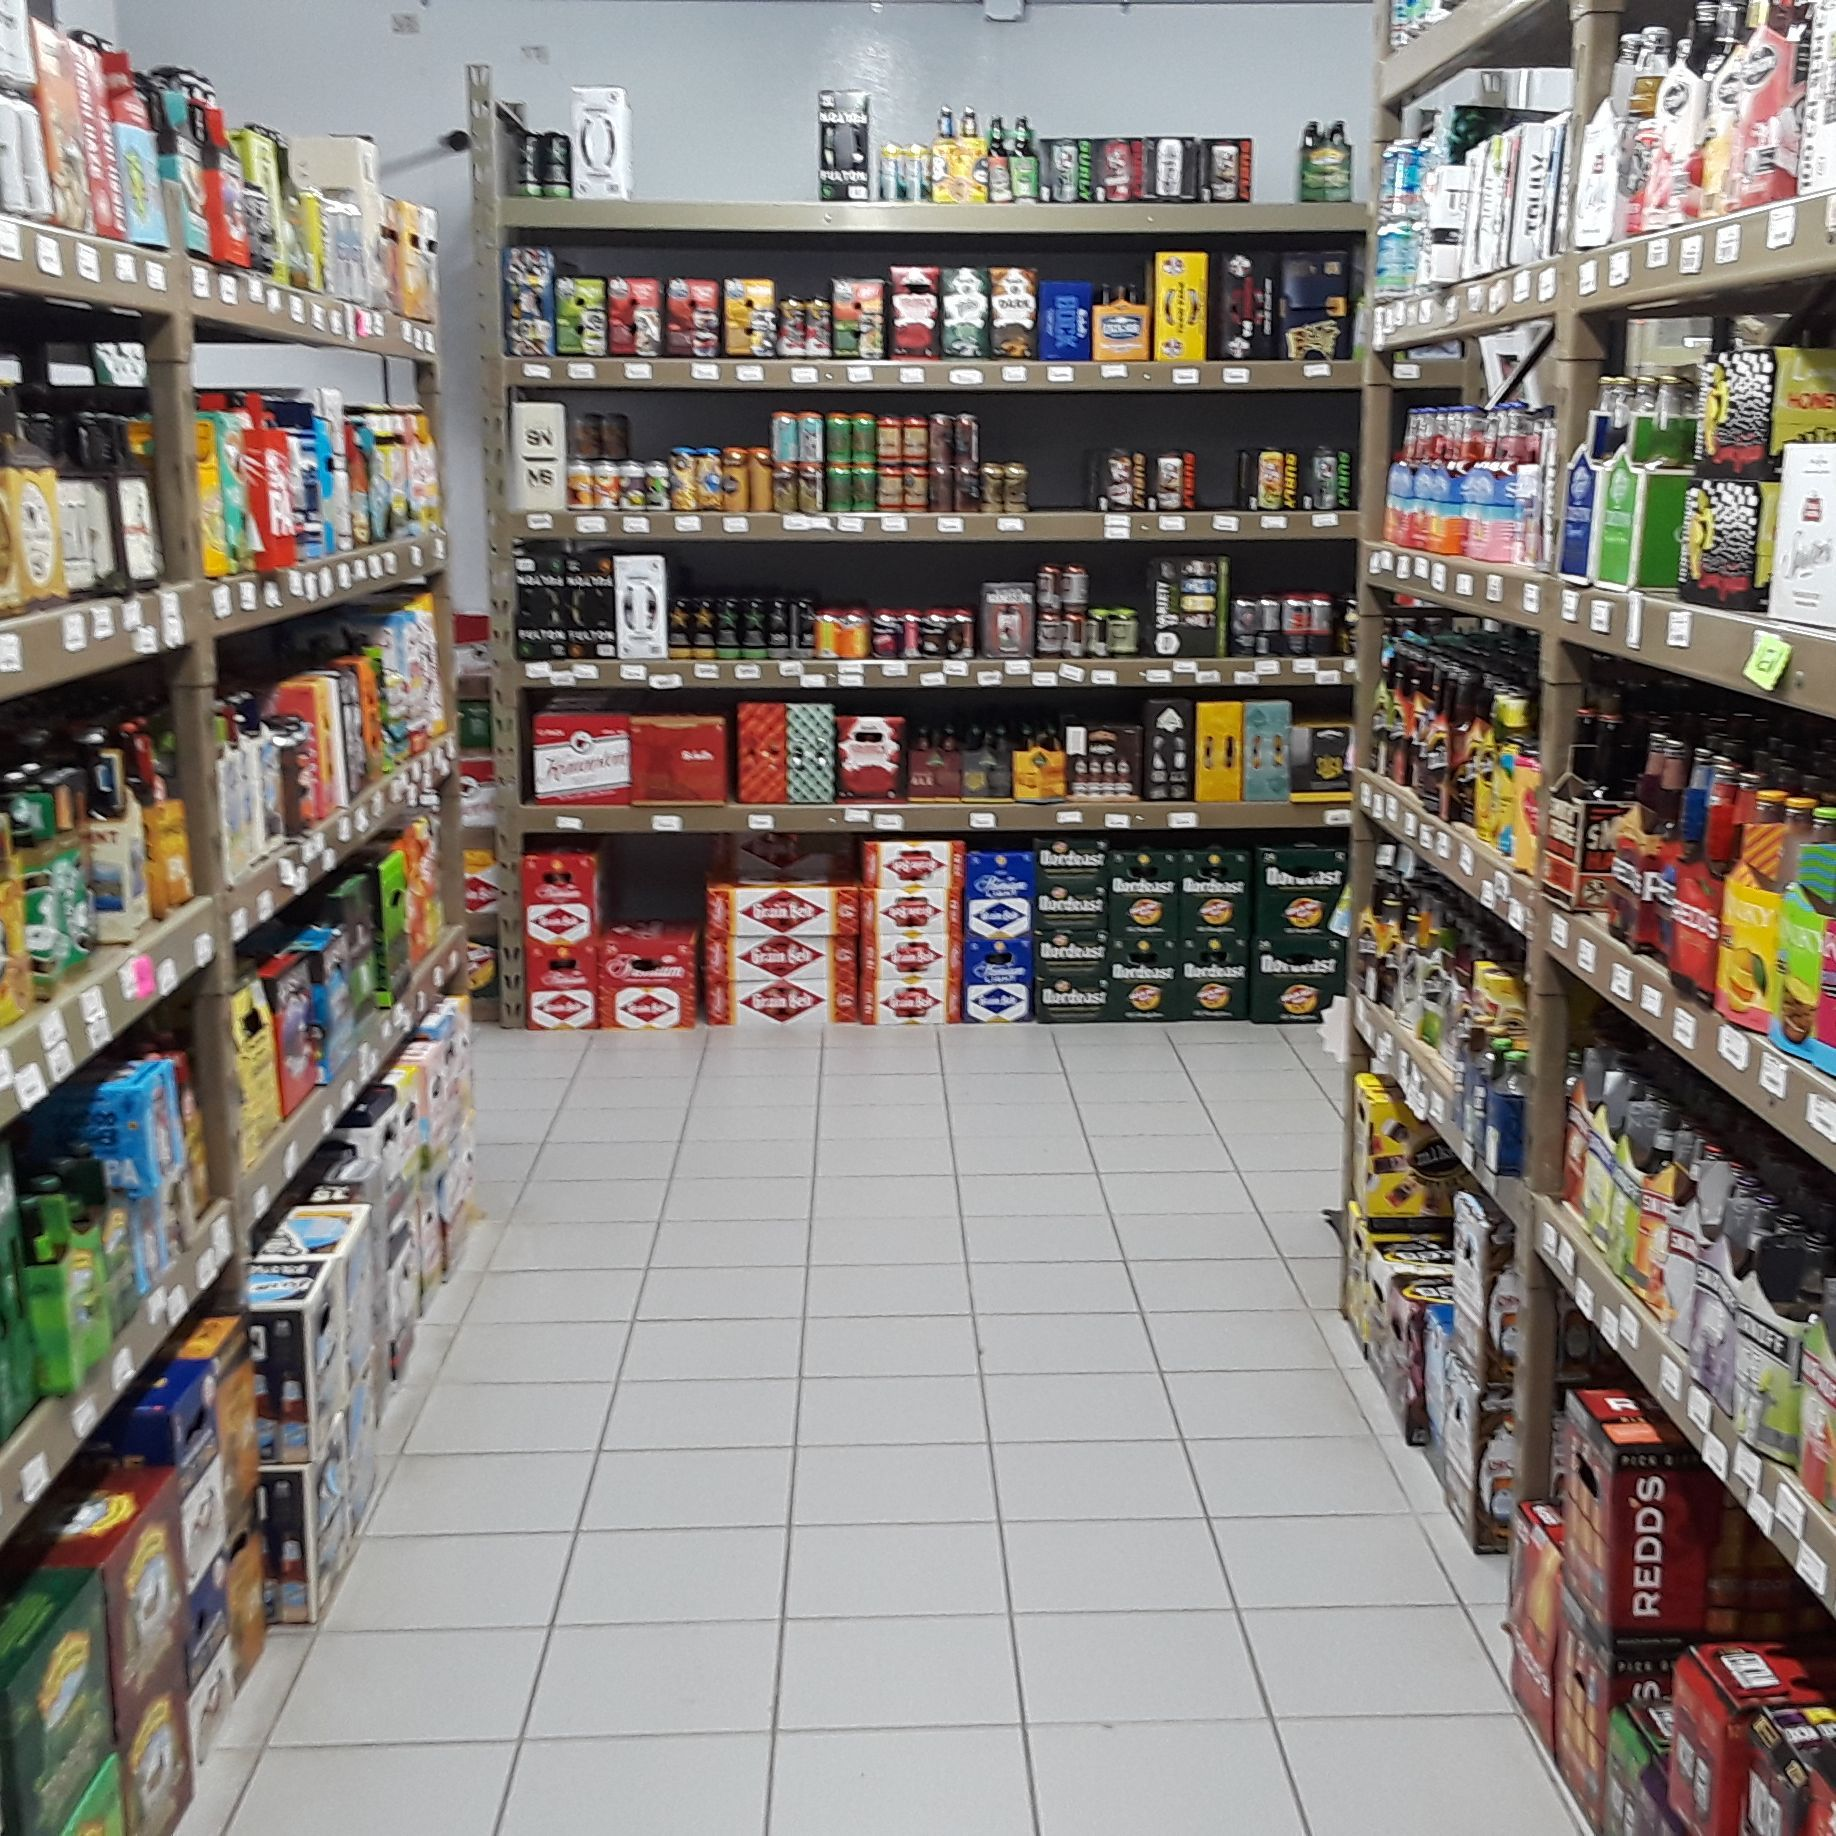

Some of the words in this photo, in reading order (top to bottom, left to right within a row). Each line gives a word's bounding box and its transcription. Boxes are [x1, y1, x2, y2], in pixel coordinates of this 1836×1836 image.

[752, 902, 788, 919] Grain
[751, 946, 787, 965] Grain
[752, 992, 788, 1010] Grain
[1628, 1475, 1667, 1618] REDD'S
